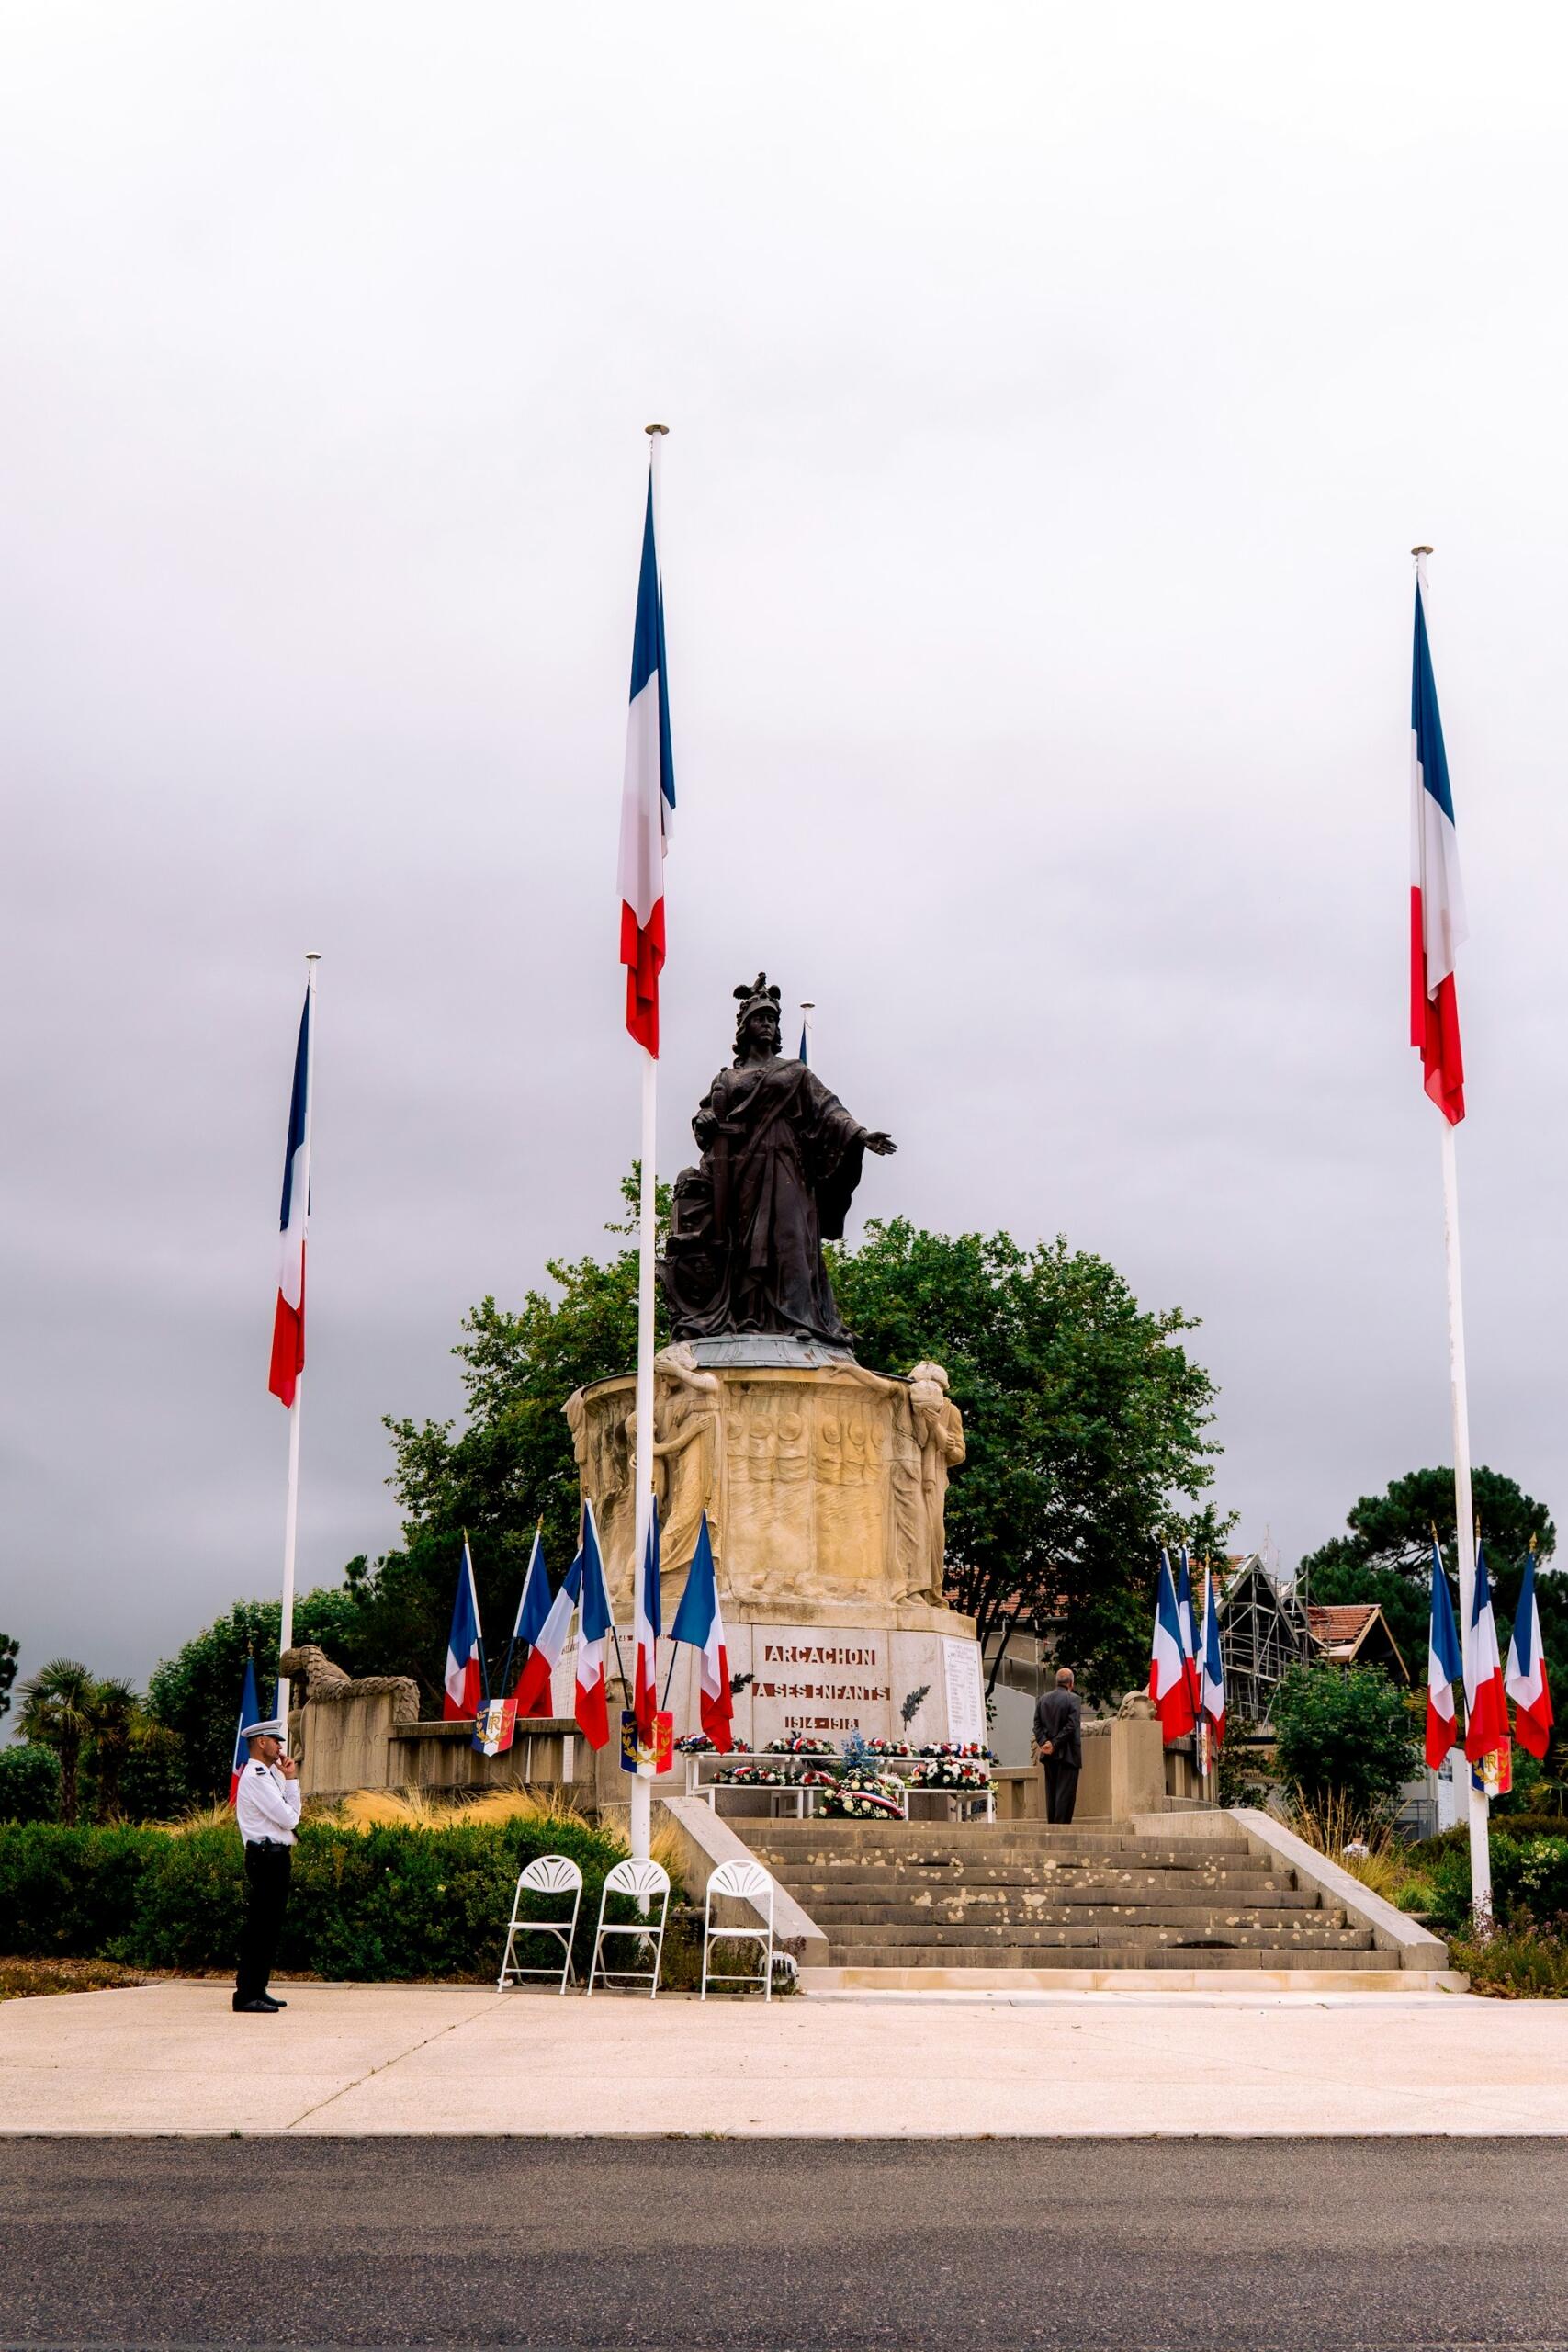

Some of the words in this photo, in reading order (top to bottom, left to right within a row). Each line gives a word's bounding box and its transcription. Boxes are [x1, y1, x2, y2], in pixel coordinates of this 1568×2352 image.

[766, 1645, 874, 1666] ARCACHON
[755, 1682, 768, 1696] A
[774, 1683, 806, 1699] SES
[811, 1685, 887, 1701] ENFANTS
